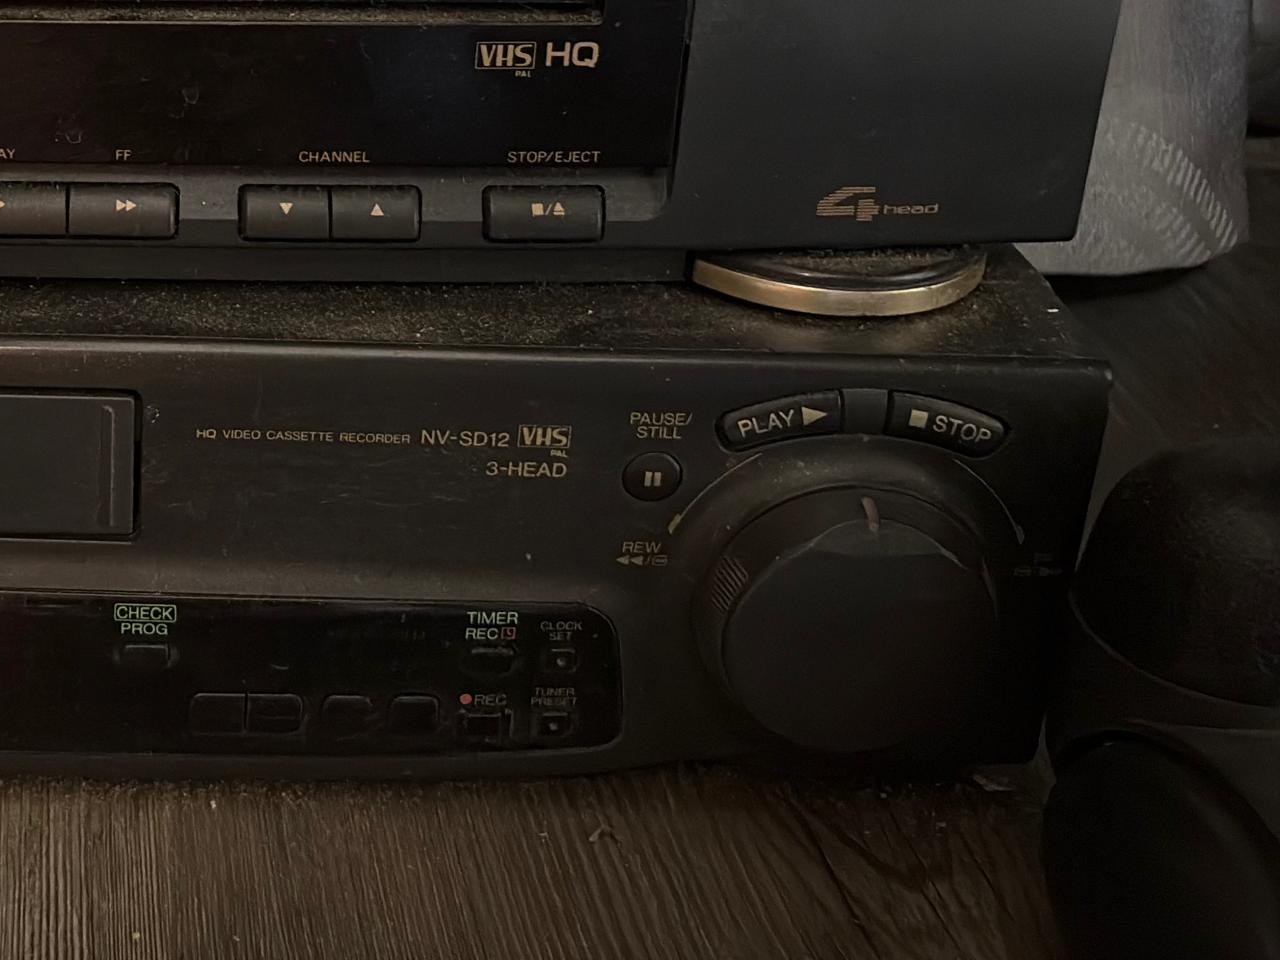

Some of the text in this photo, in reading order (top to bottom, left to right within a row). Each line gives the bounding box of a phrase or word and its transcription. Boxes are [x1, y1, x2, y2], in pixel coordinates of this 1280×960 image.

[479, 42, 600, 68] VHS HQ
[514, 69, 532, 78] PAL
[115, 149, 132, 162] FF
[298, 150, 372, 163] CHANNEL
[507, 150, 602, 163] STOP/EJECT
[882, 203, 939, 215] head
[629, 411, 693, 427] PAUSE/
[736, 408, 796, 438] PLAY
[637, 426, 682, 440] STILL
[932, 415, 993, 444] STOP
[195, 426, 569, 448] HQ VIDEO CASSETTE RECORDER NV-SD12 VHS
[485, 461, 568, 479] 3-HEAD
[622, 541, 662, 555] REW
[116, 605, 174, 621] CHECK
[467, 610, 519, 625] TIMER
[120, 622, 169, 636] PROG
[464, 626, 499, 640] REC
[540, 620, 583, 632] CLOCK
[549, 631, 572, 641] SET
[535, 686, 575, 697] TUNER
[473, 693, 507, 706] REC
